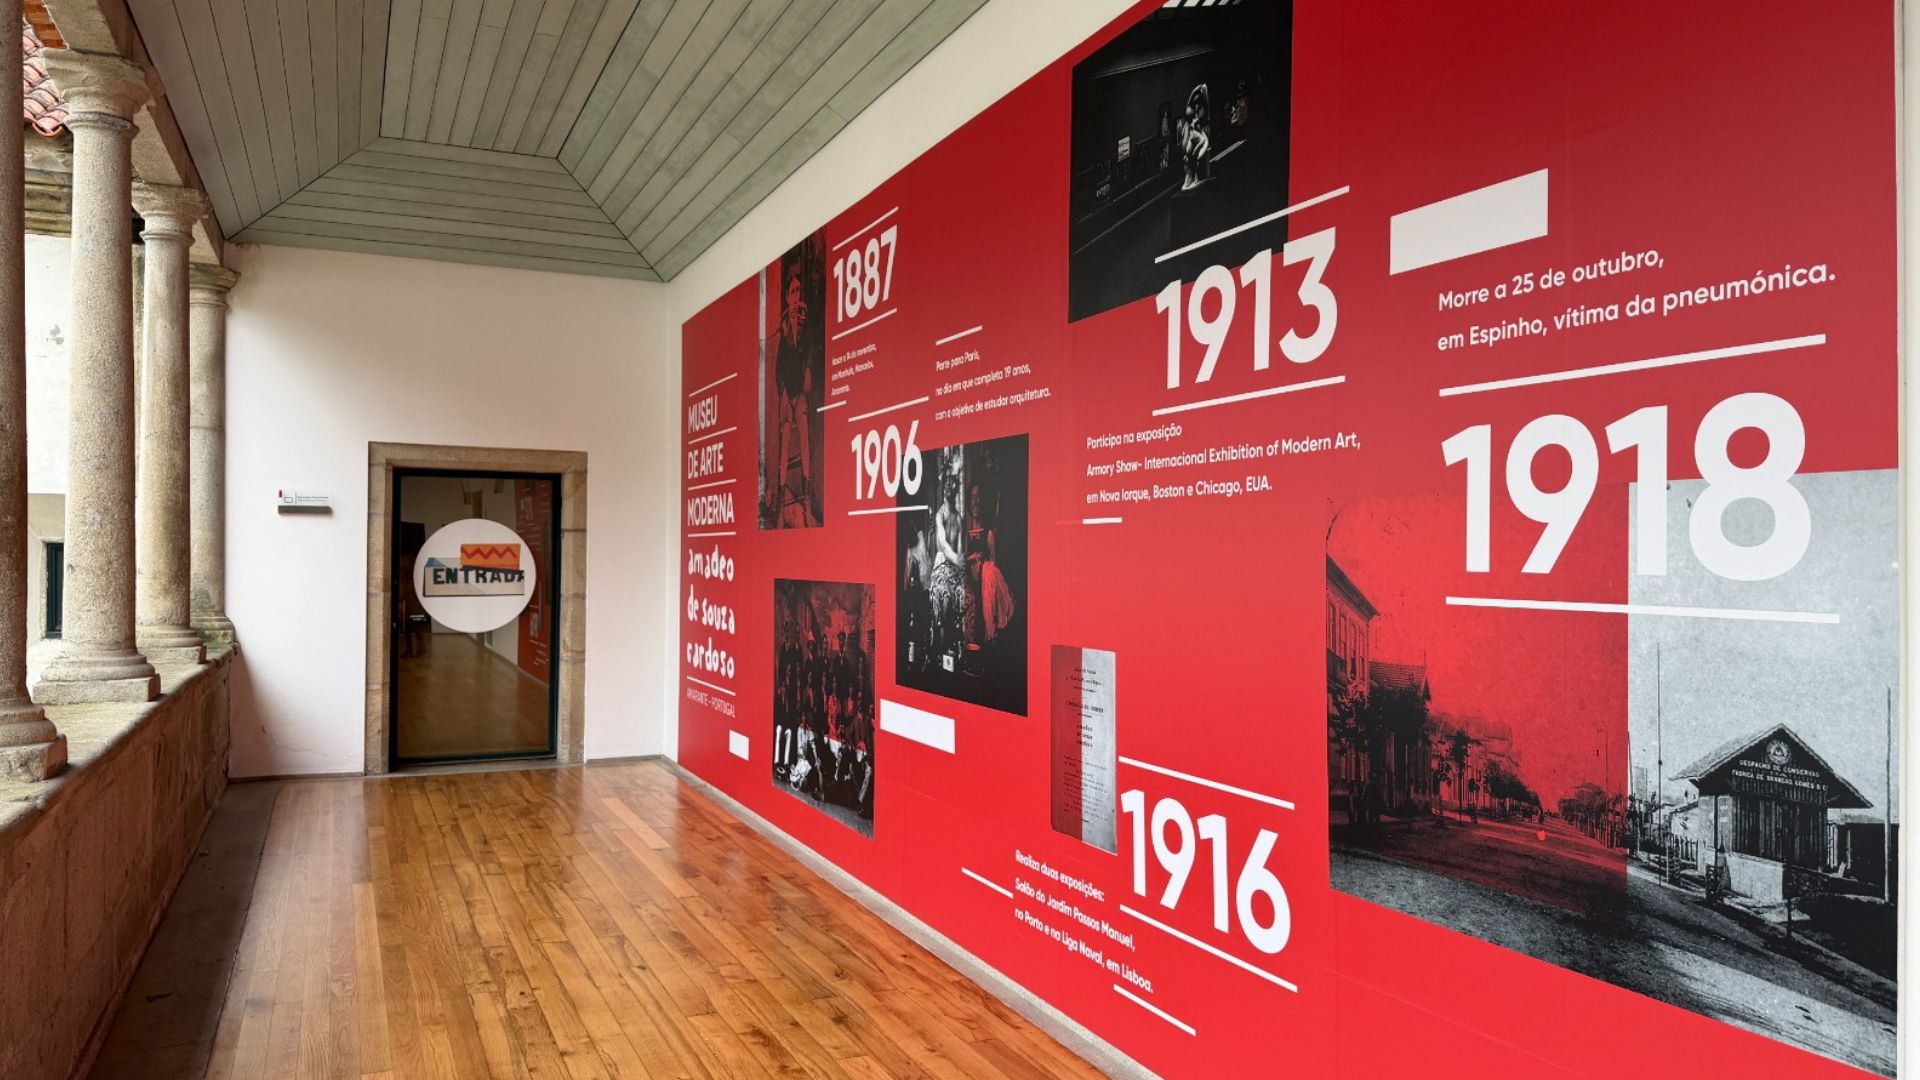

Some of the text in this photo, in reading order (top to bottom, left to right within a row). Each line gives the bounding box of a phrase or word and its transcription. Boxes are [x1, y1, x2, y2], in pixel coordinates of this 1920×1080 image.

[834, 224, 897, 323] 1887
[1439, 248, 1665, 311] Morre a 25 de outubro,
[1155, 226, 1337, 389] 1913
[1437, 262, 1836, 351] em Espinho, vítima da pneumónica.
[936, 349, 980, 371] Parte para Paris,
[943, 383, 952, 394] dia
[953, 381, 961, 391] em
[962, 379, 974, 391] que
[974, 370, 1003, 386] completa
[1004, 366, 1012, 378] 19
[1012, 363, 1031, 377] anos,
[688, 394, 718, 433] MUSEU
[952, 403, 974, 418] objetivo
[975, 400, 983, 412] de
[984, 395, 1009, 410] estudar
[1009, 387, 1051, 405] arquitetura.
[688, 442, 724, 479] DE ARTE
[851, 419, 922, 500] 1906
[1086, 423, 1182, 450] Participa na exposição
[1086, 463, 1114, 477] Armory
[1144, 449, 1206, 470] Internacional
[1209, 443, 1263, 463] Exhibition
[1266, 440, 1279, 456] of
[1281, 434, 1331, 454] Modern
[1334, 431, 1361, 450] Art,
[687, 492, 735, 526] MODERNA
[1086, 475, 1272, 504] em Nova Iorque, Boston e Chicago, EUA.
[1441, 392, 1811, 581] 1918
[687, 544, 735, 582] amadeo
[687, 583, 735, 635] de souza
[686, 636, 735, 679] cardoso
[1015, 849, 1104, 903] Realiza duas exposições:
[1121, 789, 1291, 955] 1916
[1015, 878, 1135, 952] Salão do Jardim Passos Manuel,
[1015, 908, 1153, 994] no Porto e na Liga Naval, em Lisboa.
